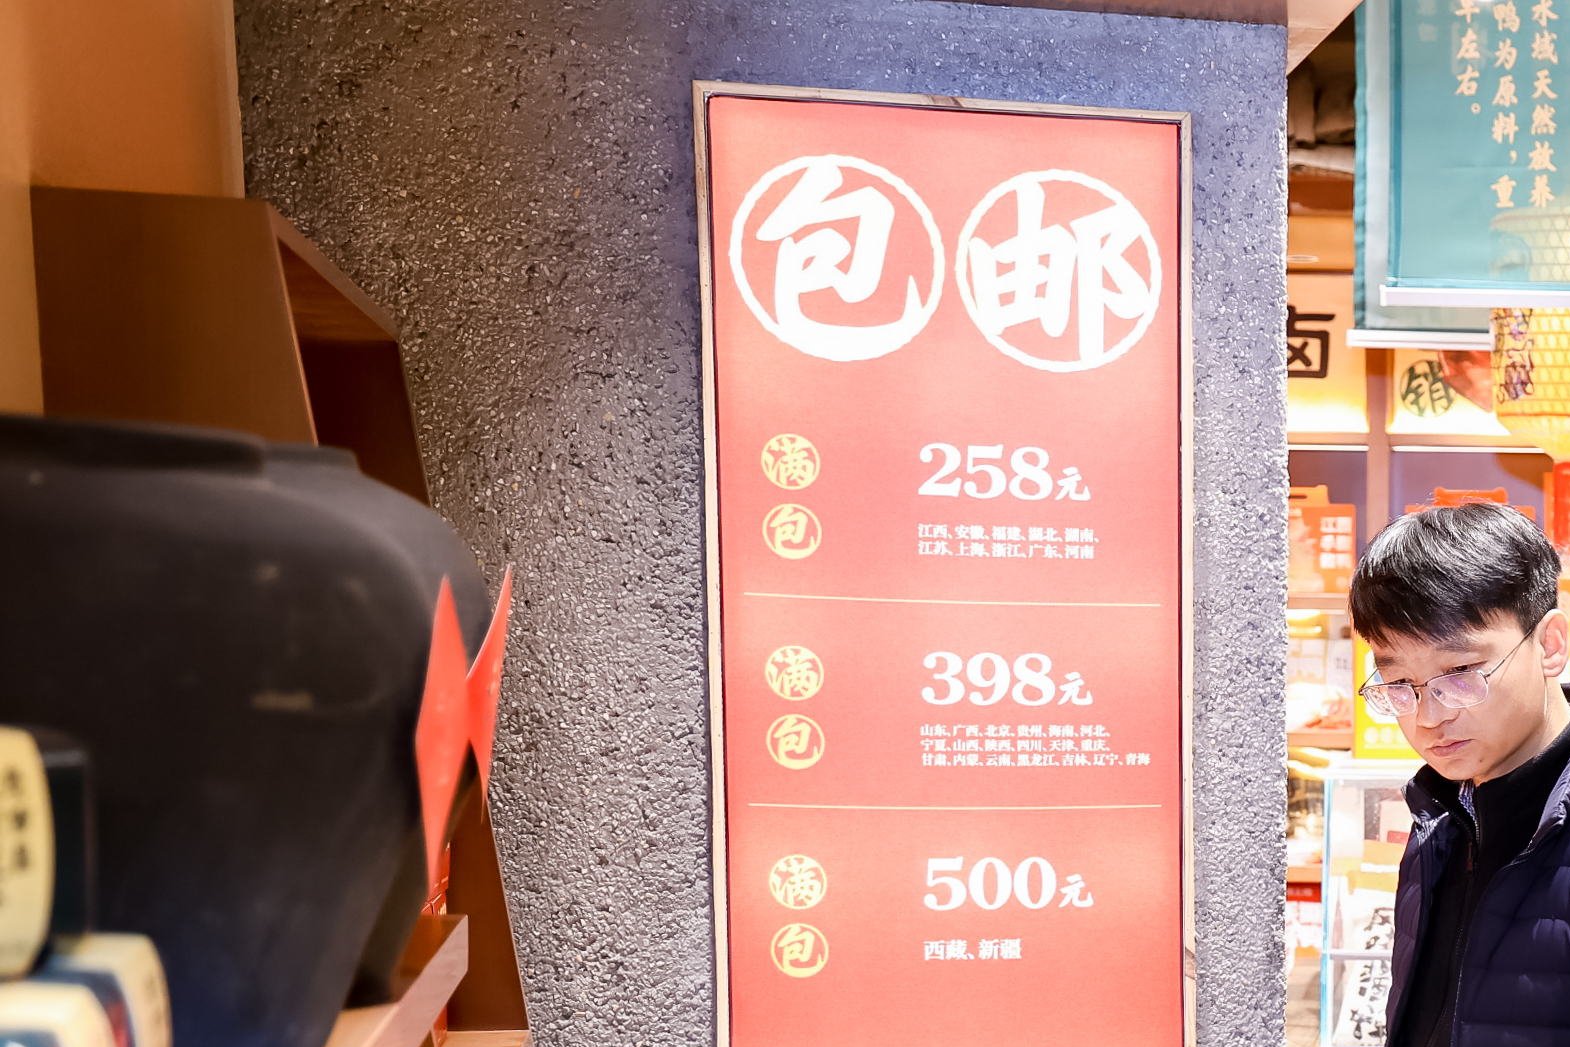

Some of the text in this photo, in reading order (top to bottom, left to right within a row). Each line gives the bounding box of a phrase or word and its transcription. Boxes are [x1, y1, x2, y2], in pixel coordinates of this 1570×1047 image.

[732, 154, 1161, 372] 包邮
[761, 433, 820, 490] 满
[917, 442, 1091, 500] 258元
[762, 503, 822, 559] 包
[918, 523, 1100, 543] 江西、安徽、福建、湖北、湖南、
[918, 540, 1095, 559] 江苏、上海、浙江、广东、河南
[765, 645, 824, 701] 满
[921, 651, 1094, 706] 398元
[766, 714, 825, 770] 包
[920, 724, 1111, 738] 山东、广西、北京、贵州、海南、河北、
[769, 854, 827, 909] 满
[923, 856, 1094, 911] 500元
[771, 923, 829, 978] 包
[923, 938, 1023, 961] 西藏、新疆
